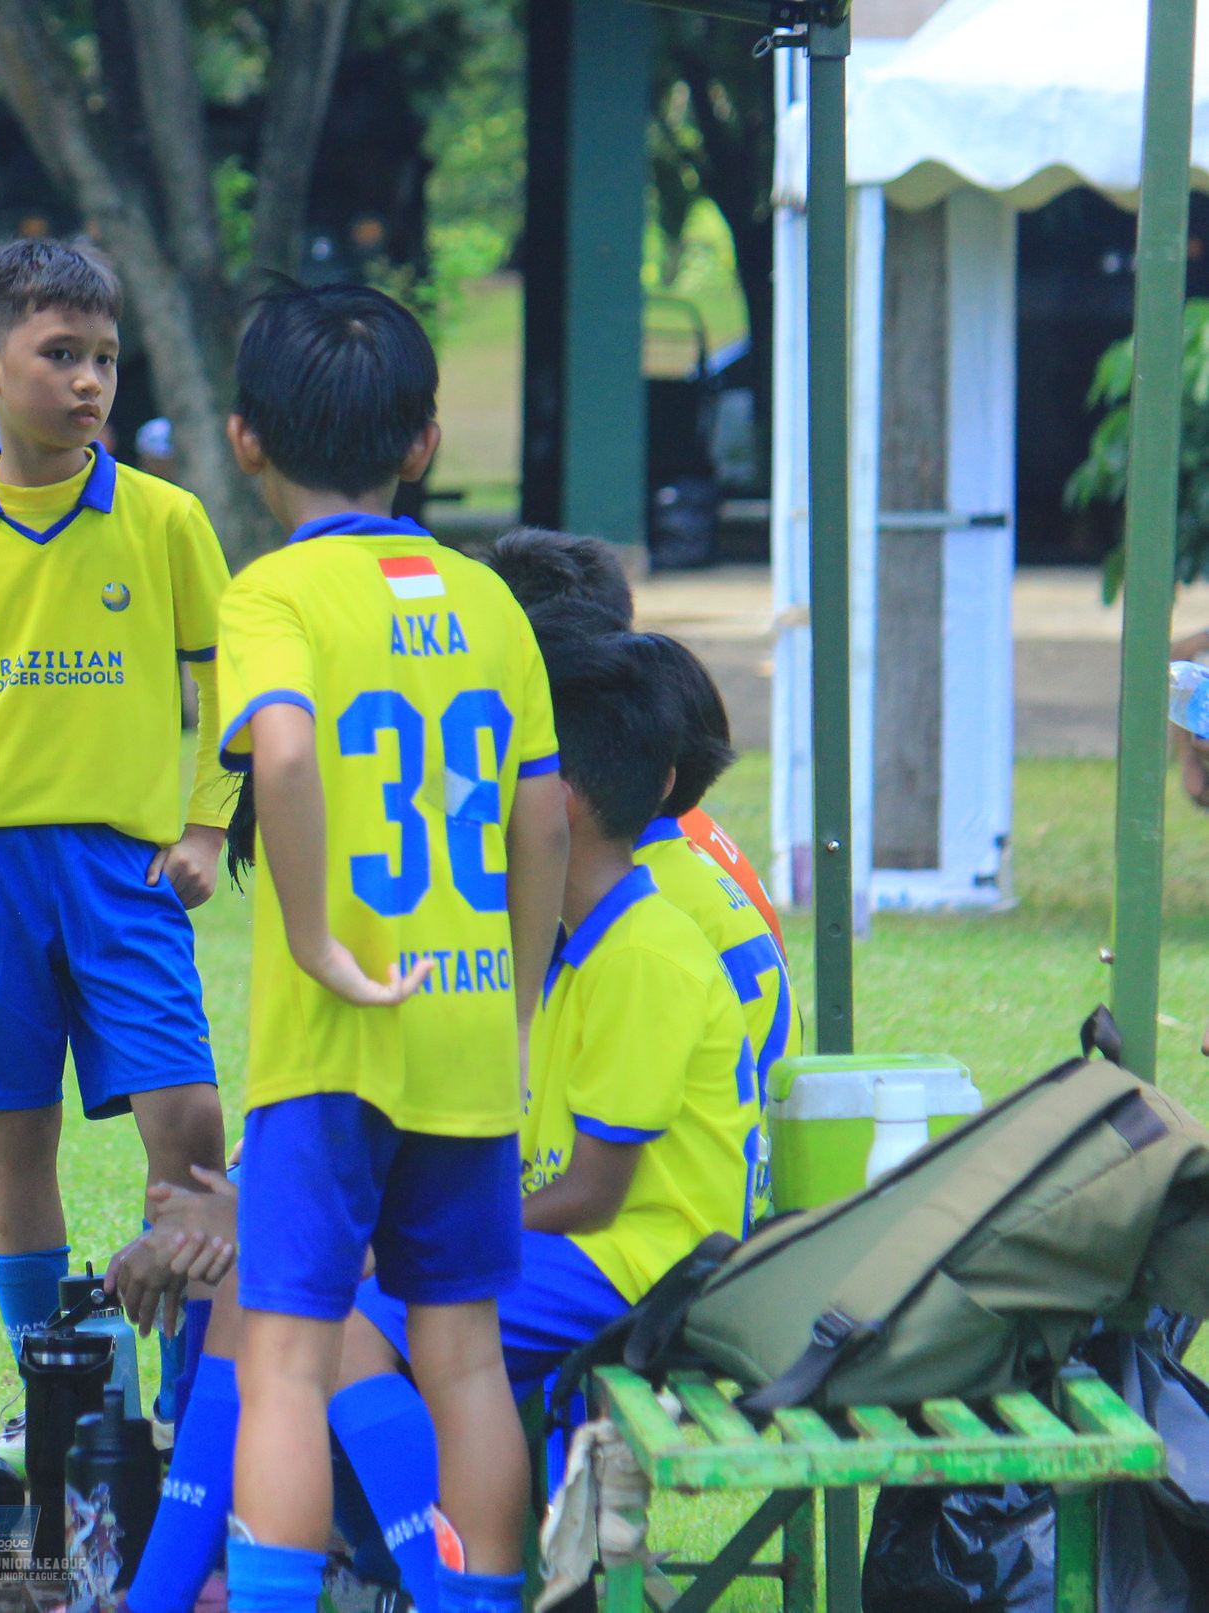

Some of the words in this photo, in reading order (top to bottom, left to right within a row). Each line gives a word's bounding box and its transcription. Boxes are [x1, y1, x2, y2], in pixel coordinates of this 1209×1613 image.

[391, 611, 470, 656] AZKA
[44, 670, 125, 685] SCHOOLS
[337, 689, 514, 917] 38
[399, 948, 511, 994] INTARO
